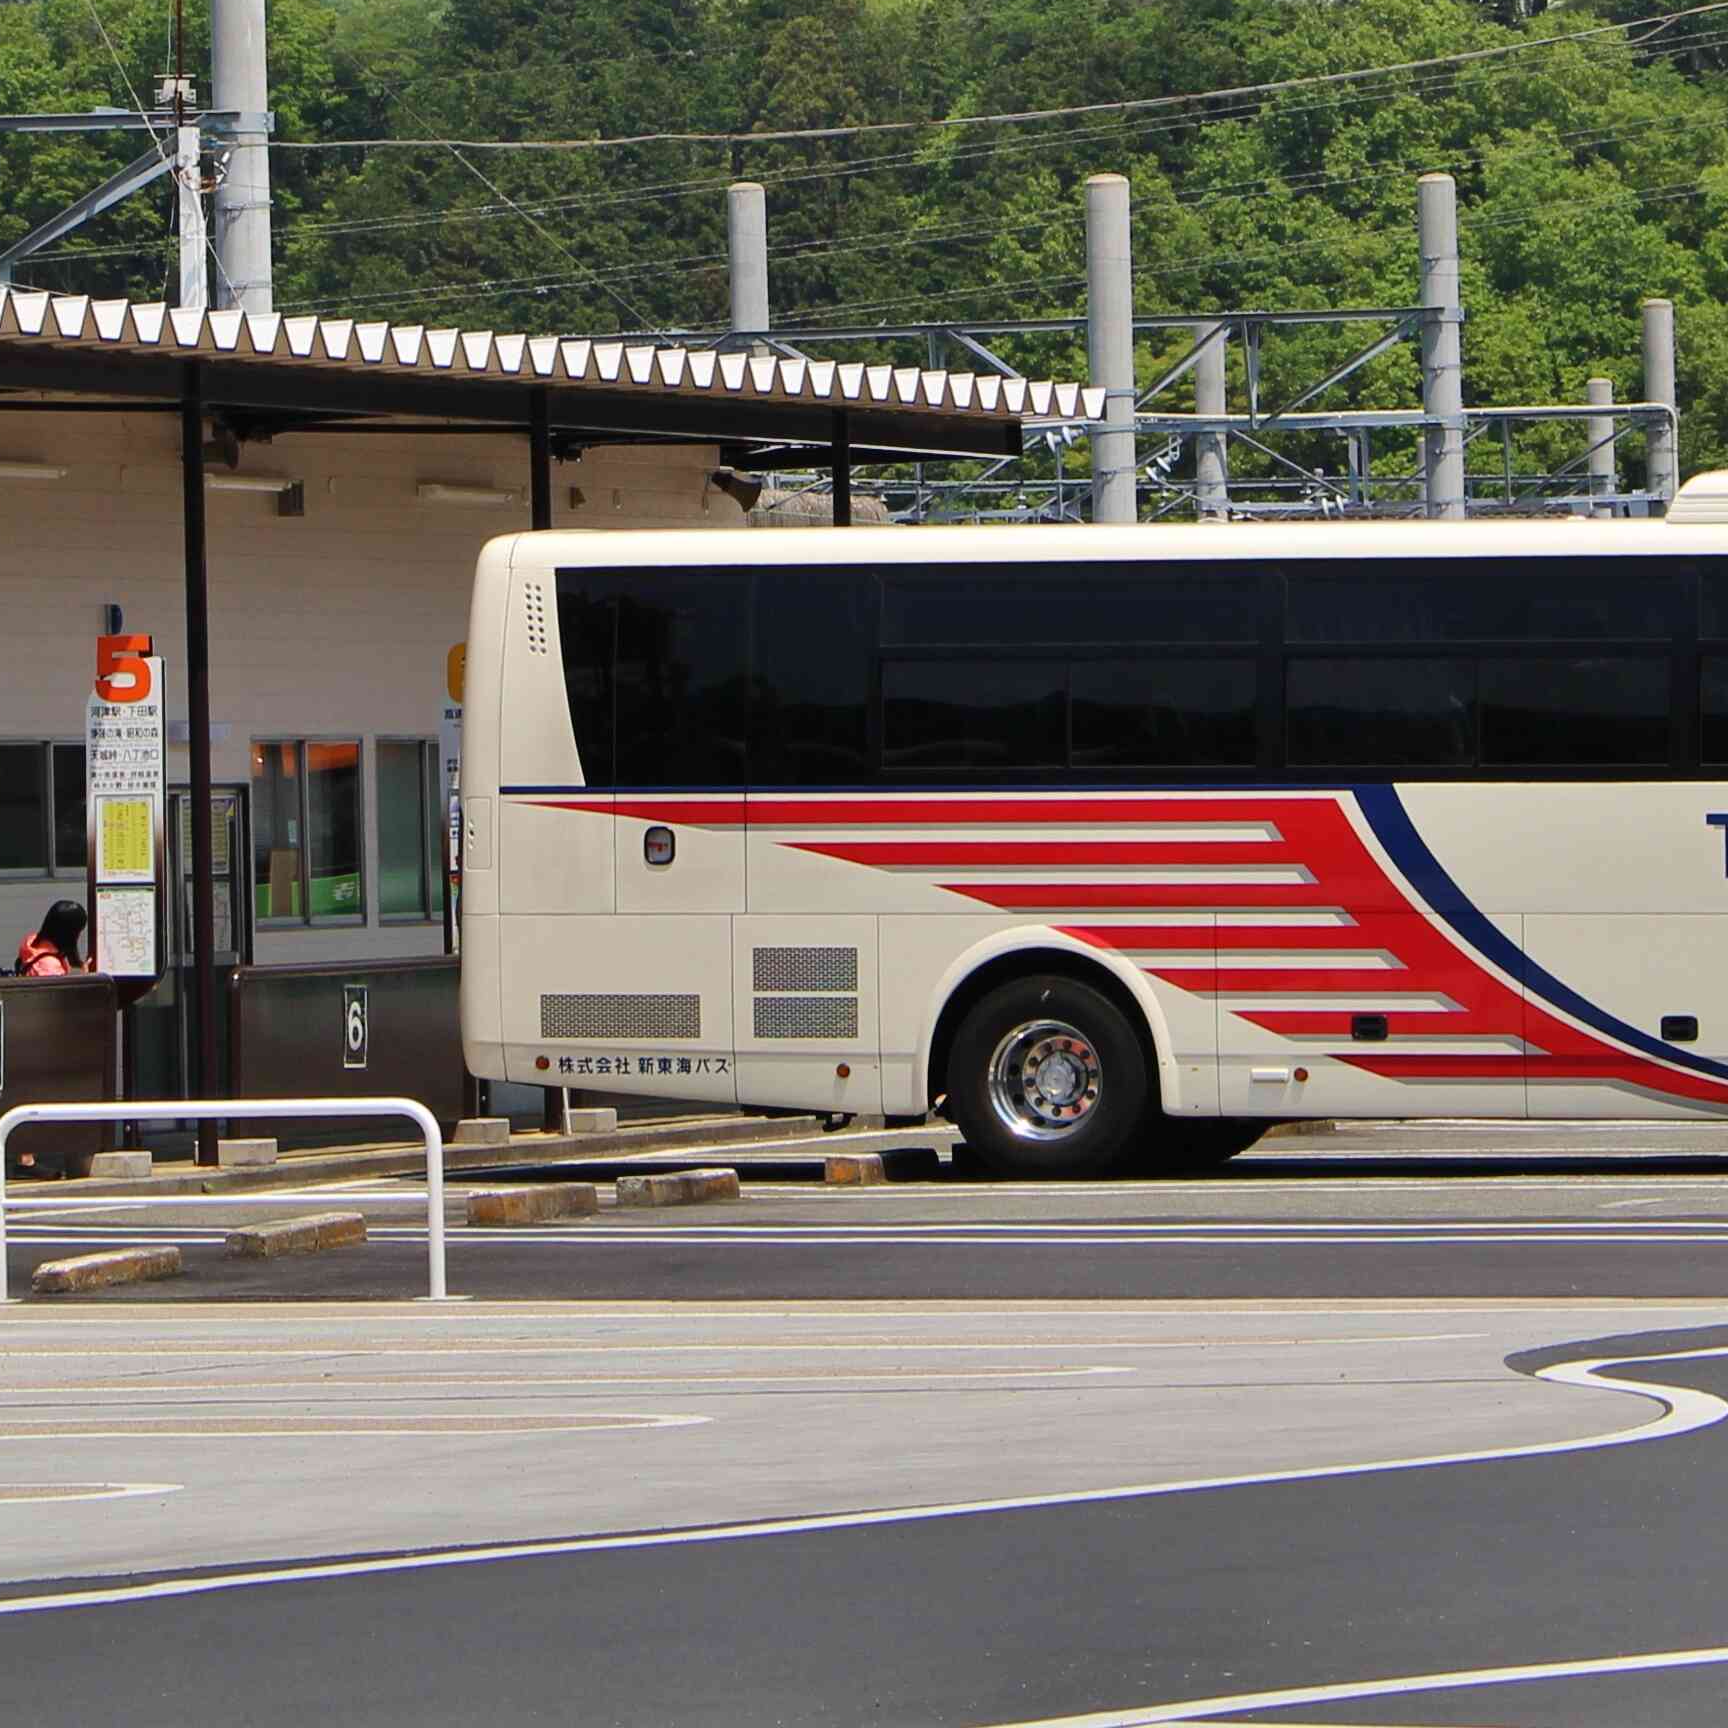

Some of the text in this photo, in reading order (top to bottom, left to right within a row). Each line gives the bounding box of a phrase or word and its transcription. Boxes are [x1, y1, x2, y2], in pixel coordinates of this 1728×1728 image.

[95, 635, 152, 703] 5
[348, 1001, 363, 1051] 6
[558, 1056, 729, 1075] 株式会社 新東海バス
